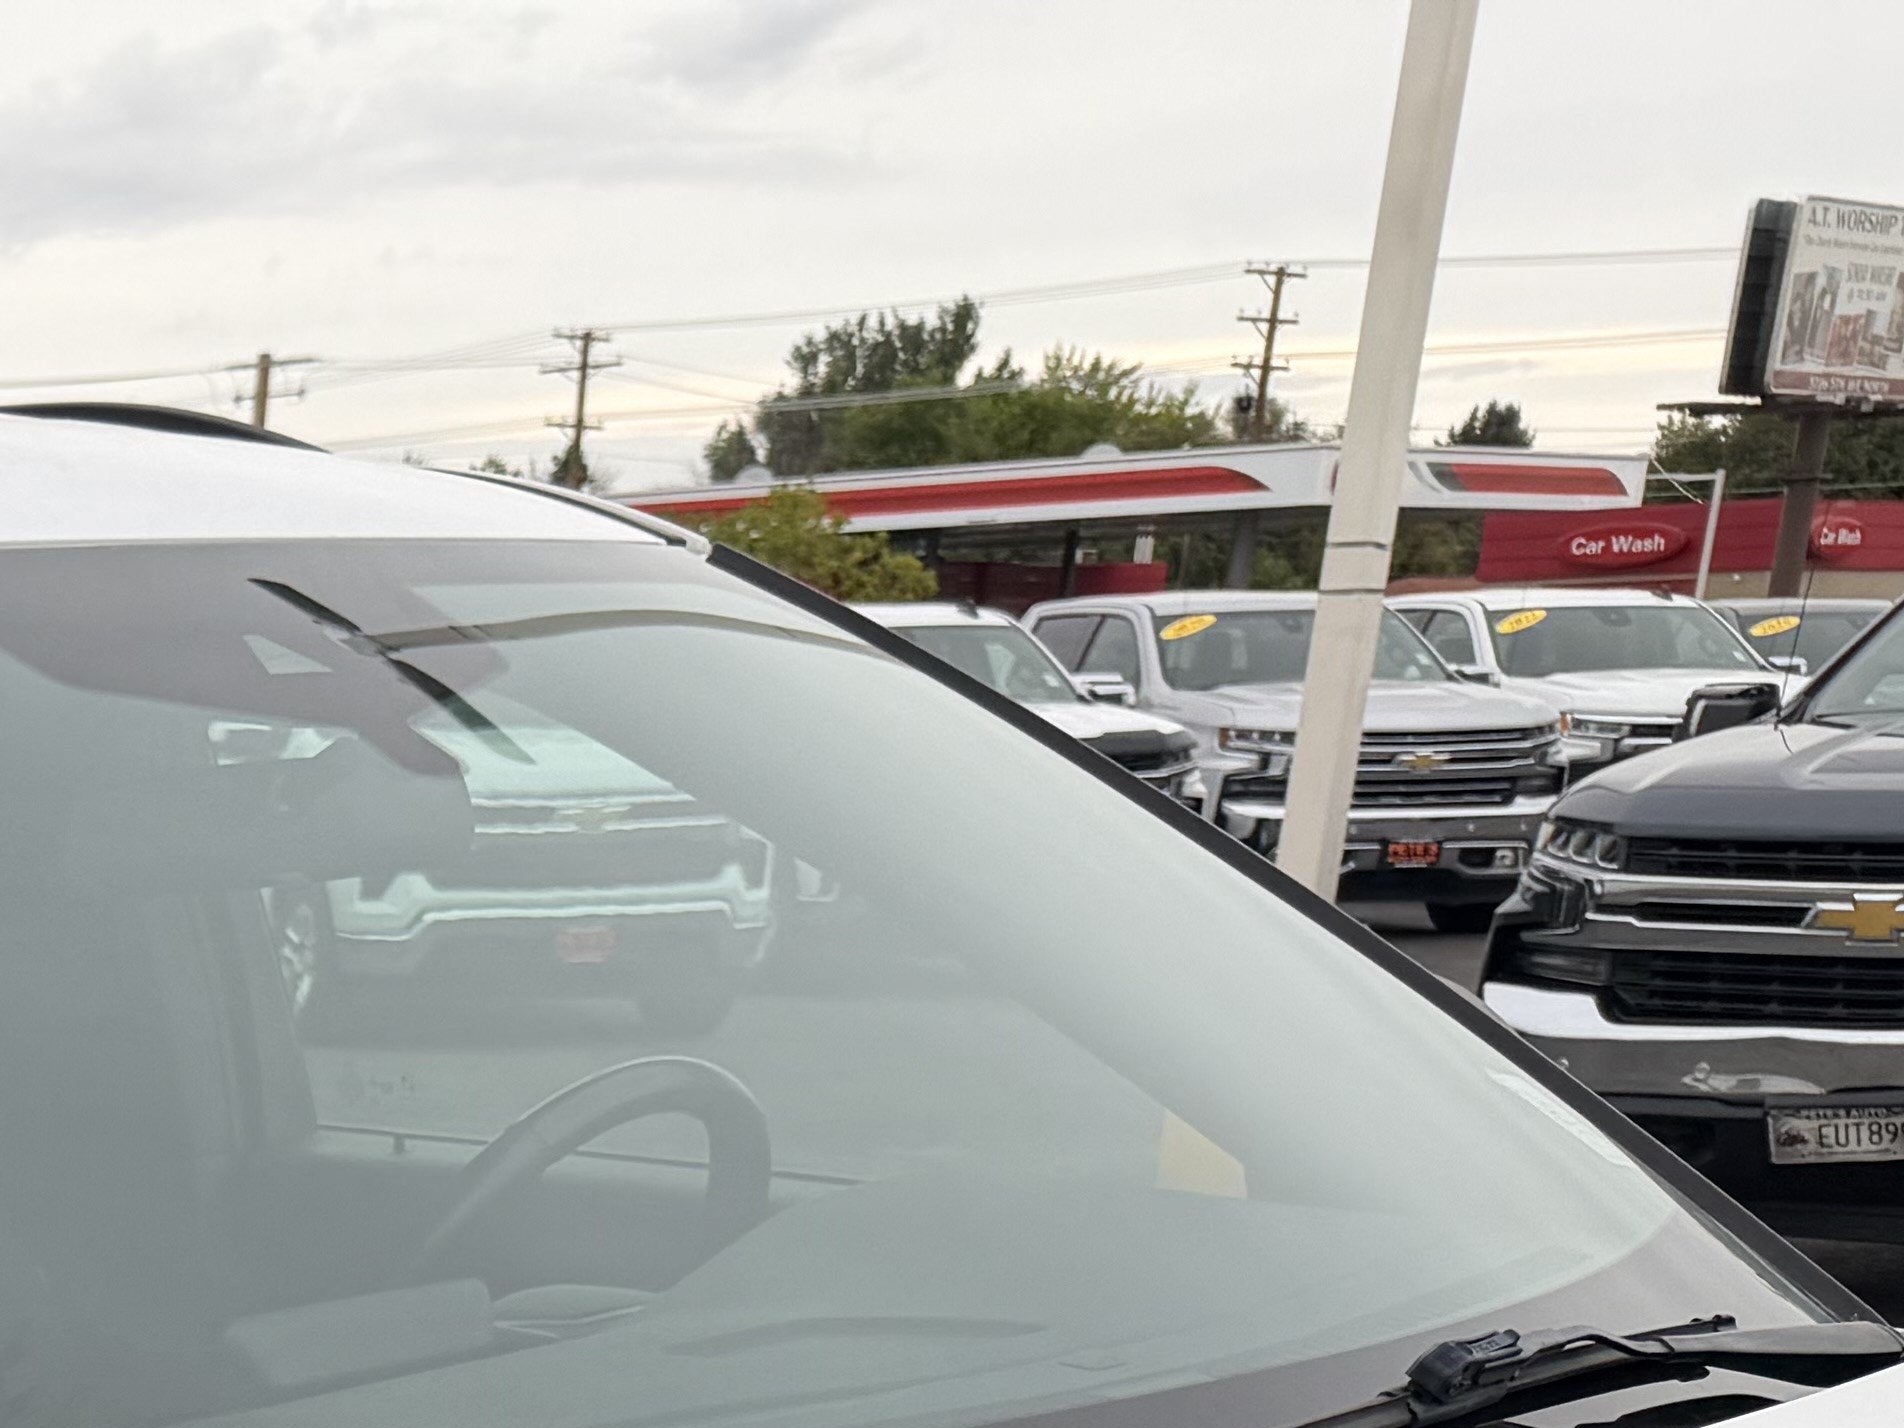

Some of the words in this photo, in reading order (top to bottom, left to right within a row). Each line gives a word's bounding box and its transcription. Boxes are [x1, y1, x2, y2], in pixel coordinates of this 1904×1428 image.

[1836, 207, 1898, 236] WORSHIP
[1571, 536, 1605, 556] Car
[1611, 533, 1665, 553] Wash
[1816, 1121, 1904, 1149] EUT89
